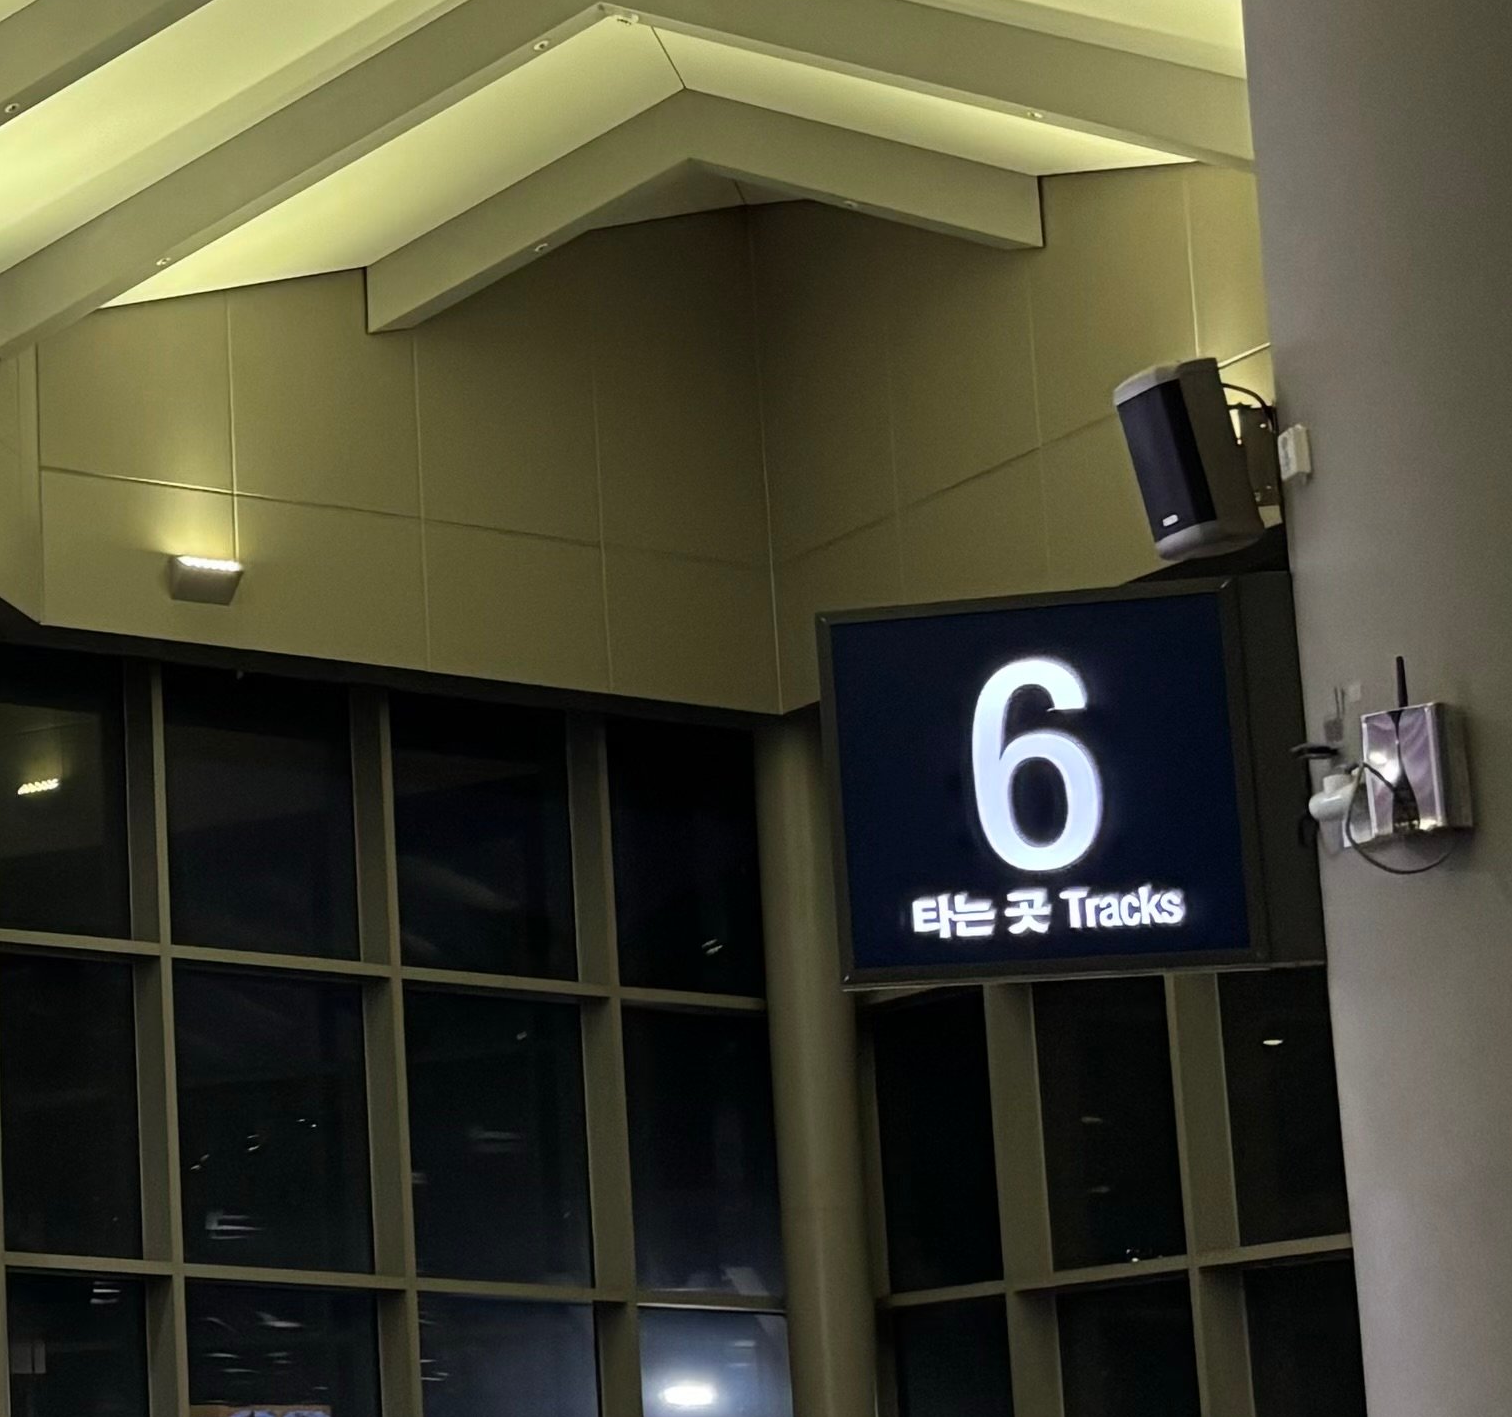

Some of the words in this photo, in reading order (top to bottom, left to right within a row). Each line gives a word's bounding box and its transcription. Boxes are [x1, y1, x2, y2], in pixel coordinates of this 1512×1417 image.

[972, 657, 1103, 871] 6
[911, 892, 996, 939] 타는
[1005, 887, 1052, 934] 곳
[1059, 884, 1186, 929] Tracks
